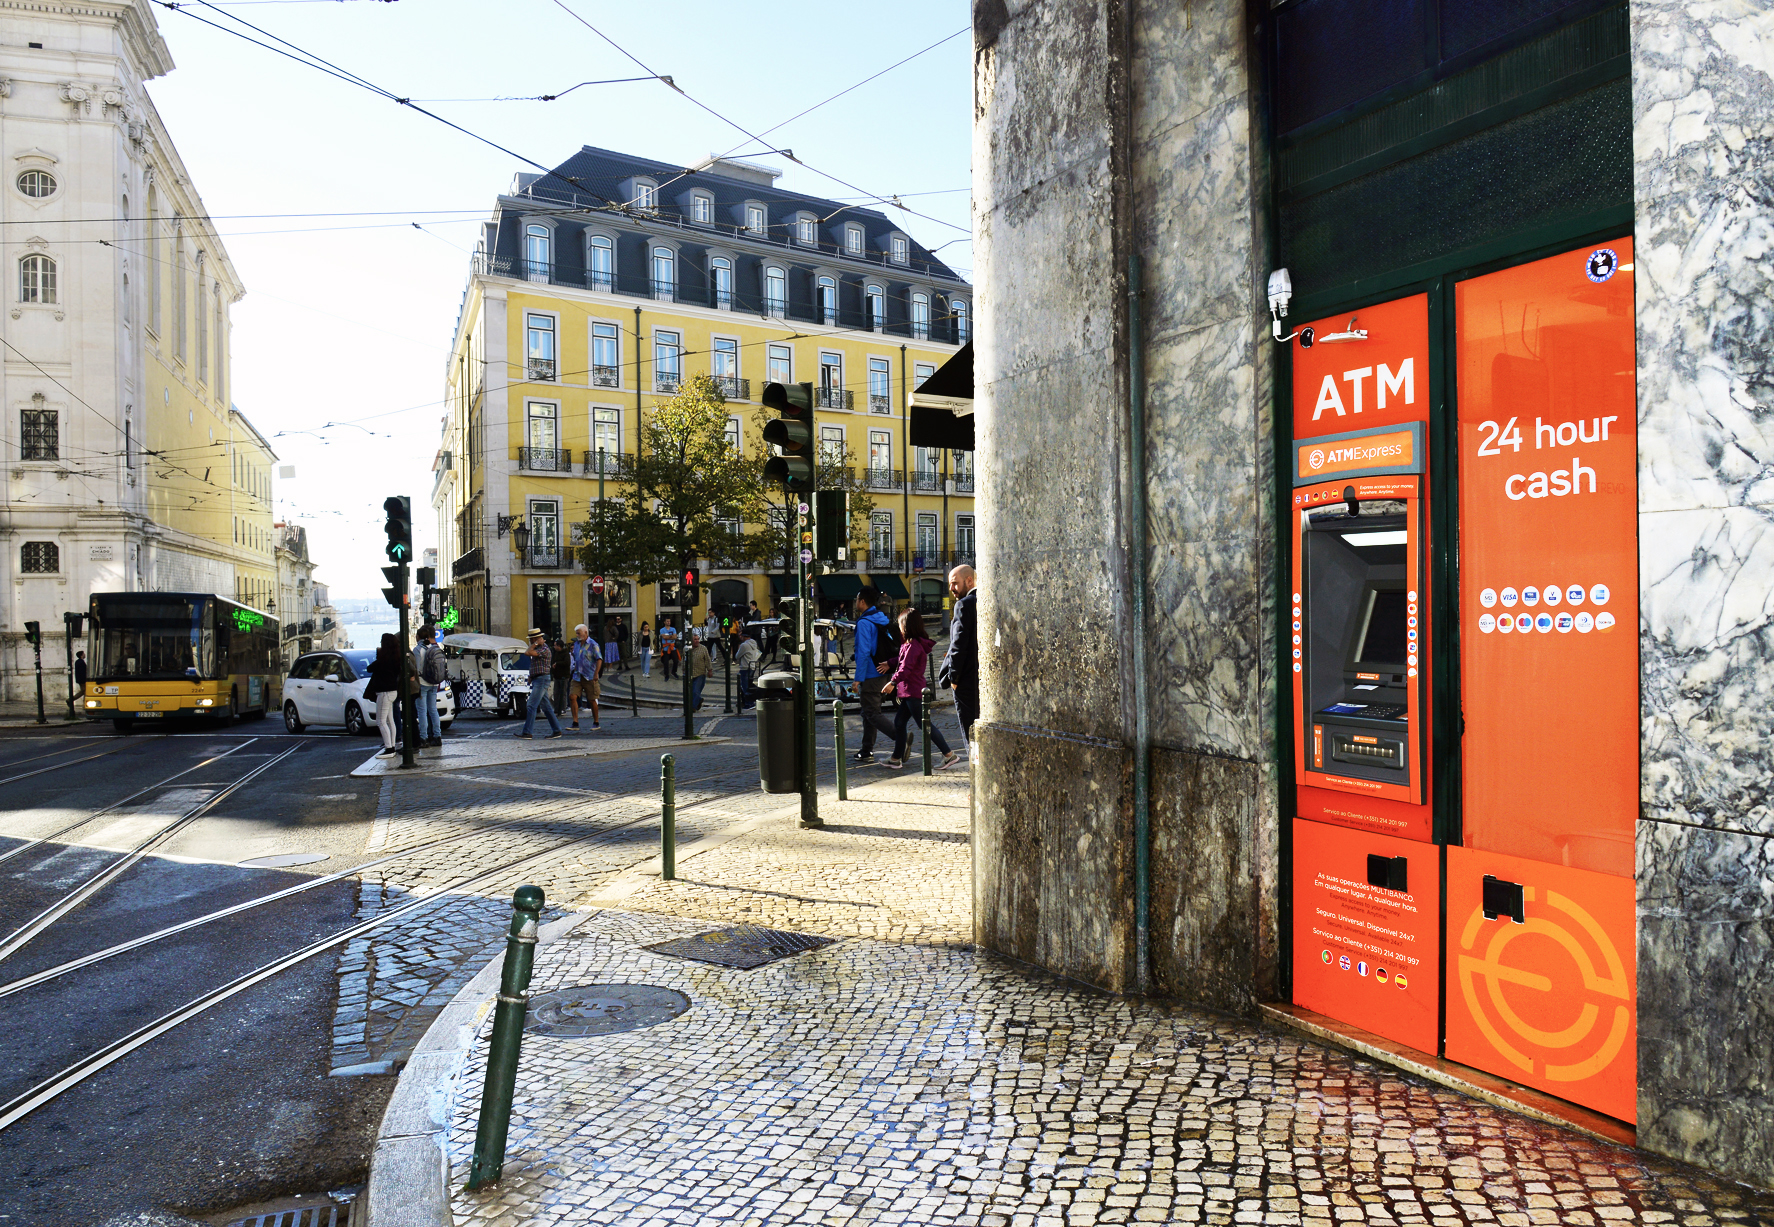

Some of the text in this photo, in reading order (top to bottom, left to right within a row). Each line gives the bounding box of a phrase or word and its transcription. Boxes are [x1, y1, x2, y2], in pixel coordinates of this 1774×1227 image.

[1312, 357, 1414, 421] ATM
[1477, 416, 1618, 457] 24 hour
[1327, 444, 1402, 464] ATMExpress
[1505, 457, 1597, 501] cash
[1323, 807, 1340, 816] Serviço
[1346, 812, 1364, 820] Cliente
[1364, 814, 1379, 823] (+351)
[1314, 880, 1324, 888] Em
[1324, 883, 1350, 894] qualquer
[1350, 889, 1366, 899] lugar.
[1374, 896, 1400, 908] qualquer
[1402, 902, 1418, 913] hora.
[1326, 875, 1338, 883] suas
[1340, 878, 1370, 890] operações
[1370, 886, 1414, 902] MULTIBANCO.
[1330, 892, 1348, 902] Express
[1348, 898, 1364, 906] access
[1316, 908, 1338, 920] Seguro.
[1338, 914, 1366, 928] Universal.
[1399, 932, 1416, 942] 24x7.
[1312, 926, 1334, 938] Serviço
[1342, 936, 1362, 948] Cliente
[1364, 944, 1382, 956] (+351)
[1384, 950, 1394, 958] 214
[1395, 952, 1406, 962] 201
[1407, 956, 1420, 966] 997
